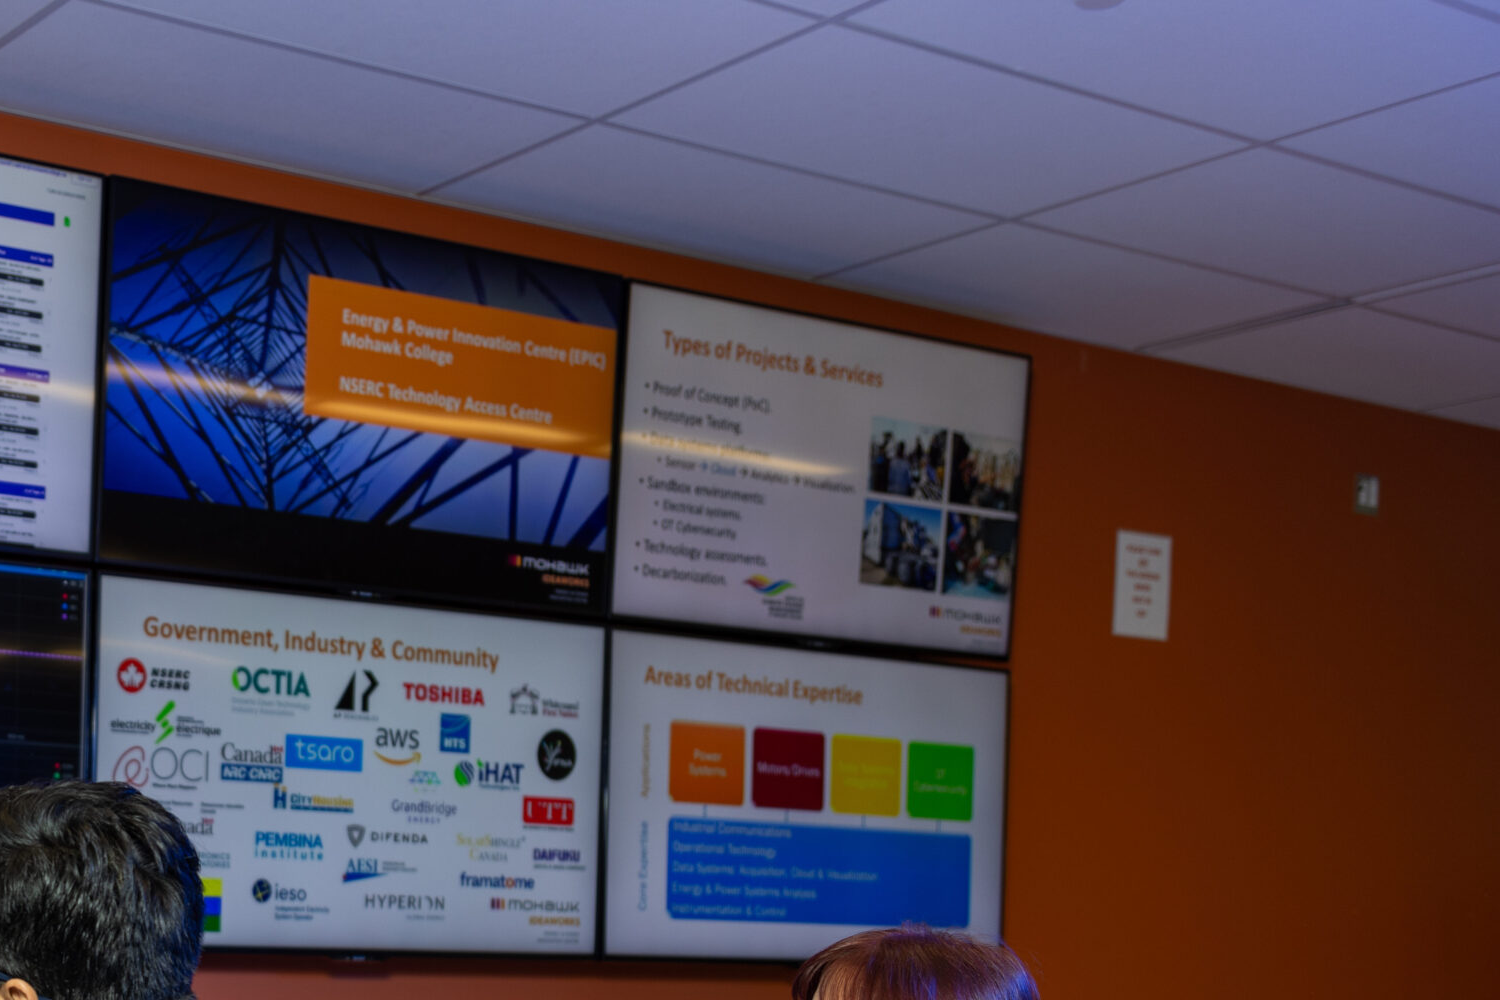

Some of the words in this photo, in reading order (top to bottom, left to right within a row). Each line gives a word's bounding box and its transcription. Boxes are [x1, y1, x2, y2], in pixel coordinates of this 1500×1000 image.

[341, 331, 401, 356] Mohawk
[404, 342, 454, 366] College
[342, 308, 389, 333] Energy
[392, 318, 404, 333] &
[407, 321, 449, 342] Power
[452, 328, 521, 354] Innovation
[524, 341, 566, 362] Centre
[569, 349, 606, 371] (EPIC)
[663, 329, 710, 358] Types
[714, 341, 732, 361] of
[735, 344, 800, 374] Projects
[803, 356, 816, 375] &
[820, 360, 884, 388] Services
[340, 376, 384, 398] NSERC
[387, 384, 461, 412] Technology
[464, 396, 506, 417] Access
[510, 403, 553, 425] Centre
[651, 405, 702, 428] Prototype
[647, 476, 692, 496] Sandbox
[644, 539, 702, 561] Technology
[143, 616, 278, 652] Government,
[285, 630, 365, 660] Industry
[371, 637, 385, 659] &
[392, 640, 499, 674] Community
[151, 667, 190, 680] NSERC
[232, 665, 310, 697] OCTIA
[403, 682, 486, 706] TOSHIBA
[644, 665, 691, 689] Areas
[695, 671, 712, 691] of
[716, 672, 789, 699] Technical
[793, 680, 863, 706] Expertise
[110, 718, 156, 733] electricity
[375, 727, 420, 750] aws
[151, 747, 209, 782] OCI
[221, 742, 283, 765] Canada
[478, 758, 524, 784] iHAT
[391, 799, 457, 817] GrandBridge
[255, 830, 324, 849] PEMBINA
[371, 832, 428, 844] DIFENDA
[533, 847, 580, 863] DAIFUKU
[275, 883, 307, 901] ieso
[460, 871, 535, 890] framatome
